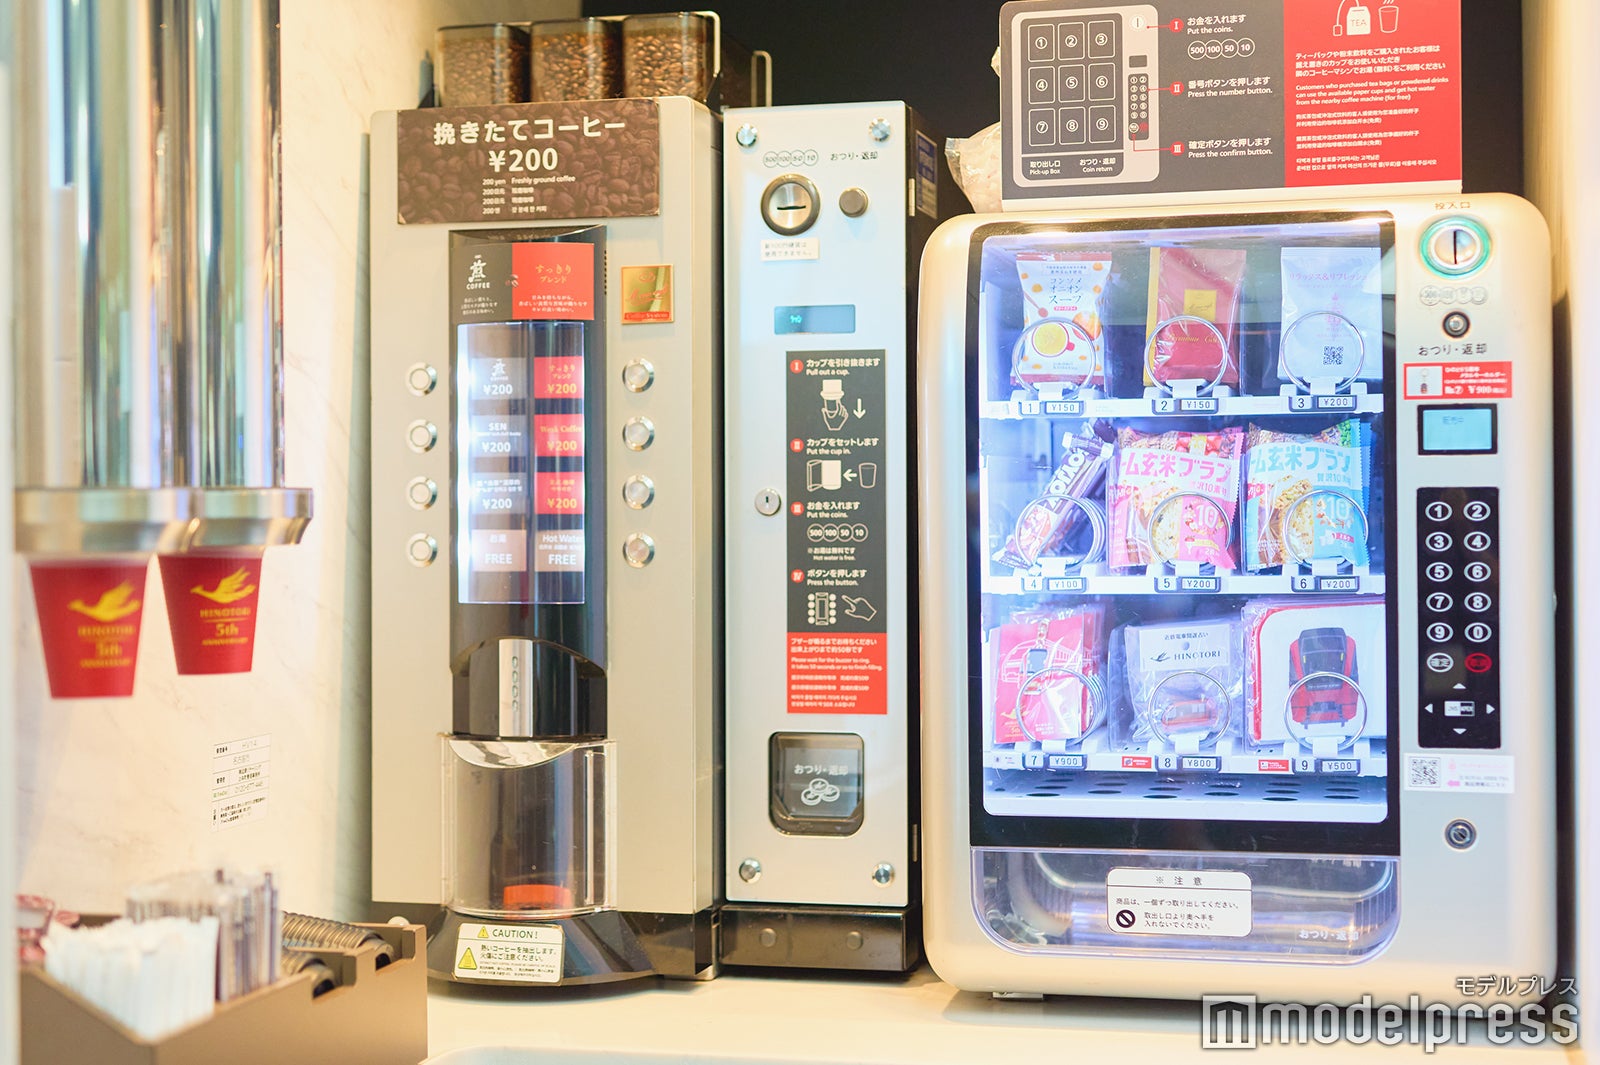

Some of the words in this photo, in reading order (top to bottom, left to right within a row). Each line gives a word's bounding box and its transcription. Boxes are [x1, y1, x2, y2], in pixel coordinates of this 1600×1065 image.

[1187, 14, 1246, 26] お金を入れます
[1190, 46, 1204, 54] 500
[1206, 45, 1220, 53] 100
[1224, 44, 1234, 52] 50
[1240, 44, 1250, 52] 10
[1188, 76, 1270, 89] 番号ボタンを押します
[434, 116, 626, 146] 挽きたてコーヒー
[1188, 138, 1272, 150] 確定ボタンを押します
[488, 148, 558, 173] ¥200
[830, 151, 878, 161] おつり・返却
[1030, 160, 1060, 168] 取り出し口
[533, 176, 556, 184] ground
[536, 264, 572, 274] すっきり
[540, 276, 568, 284] ブレンド
[466, 282, 490, 290] COFFEE
[1050, 285, 1082, 294] オニオン
[1419, 344, 1487, 356] おつり・返却
[484, 384, 513, 395] ¥200
[547, 383, 577, 394] ¥200
[1028, 403, 1032, 413] 1
[1051, 404, 1075, 412] ¥150
[1161, 400, 1168, 411] 2
[1186, 401, 1211, 409] ¥150
[1298, 398, 1305, 408] 3
[489, 423, 507, 431] SEN
[482, 442, 511, 452] ¥200
[547, 440, 577, 451] ¥200
[807, 438, 879, 447] カップをセットします
[482, 498, 512, 509] ¥200
[547, 498, 577, 509] ¥200
[807, 501, 860, 510] お金を入れます
[1327, 496, 1348, 518] 10
[1196, 505, 1218, 528] 10
[1434, 505, 1442, 518] 1
[1472, 505, 1482, 518] 2
[1434, 535, 1444, 548] 3
[1472, 535, 1483, 548] 4
[485, 554, 512, 564] FREE
[548, 554, 576, 565] FREE
[807, 569, 867, 578] ボタンを押します
[1434, 566, 1444, 578] 5
[1472, 566, 1483, 578] 6
[1030, 579, 1036, 588] 4
[1164, 579, 1170, 588] 5
[1187, 580, 1211, 588] ¥200
[1300, 578, 1307, 588] 6
[1434, 596, 1444, 608] 7
[1472, 596, 1483, 608] 8
[216, 623, 239, 637] 5th
[1435, 626, 1445, 638] 9
[1473, 626, 1483, 638] 0
[1174, 651, 1221, 660] HINOTORI
[1031, 756, 1037, 765] 7
[1164, 758, 1171, 768] 8
[1188, 760, 1211, 768] ¥800
[1302, 760, 1308, 770] 9
[794, 764, 848, 776] おつり・返却
[1116, 897, 1239, 909] 商品は、一個ずつ取り出してください。
[1144, 912, 1215, 921] 取出し口より奥へ手を
[1144, 921, 1210, 929] 入れないでください。
[1299, 929, 1359, 941] おつり・返却
[481, 944, 556, 955] 熱いコーヒーを抽出します。
[481, 952, 543, 962] 火傷にご注意ください。
